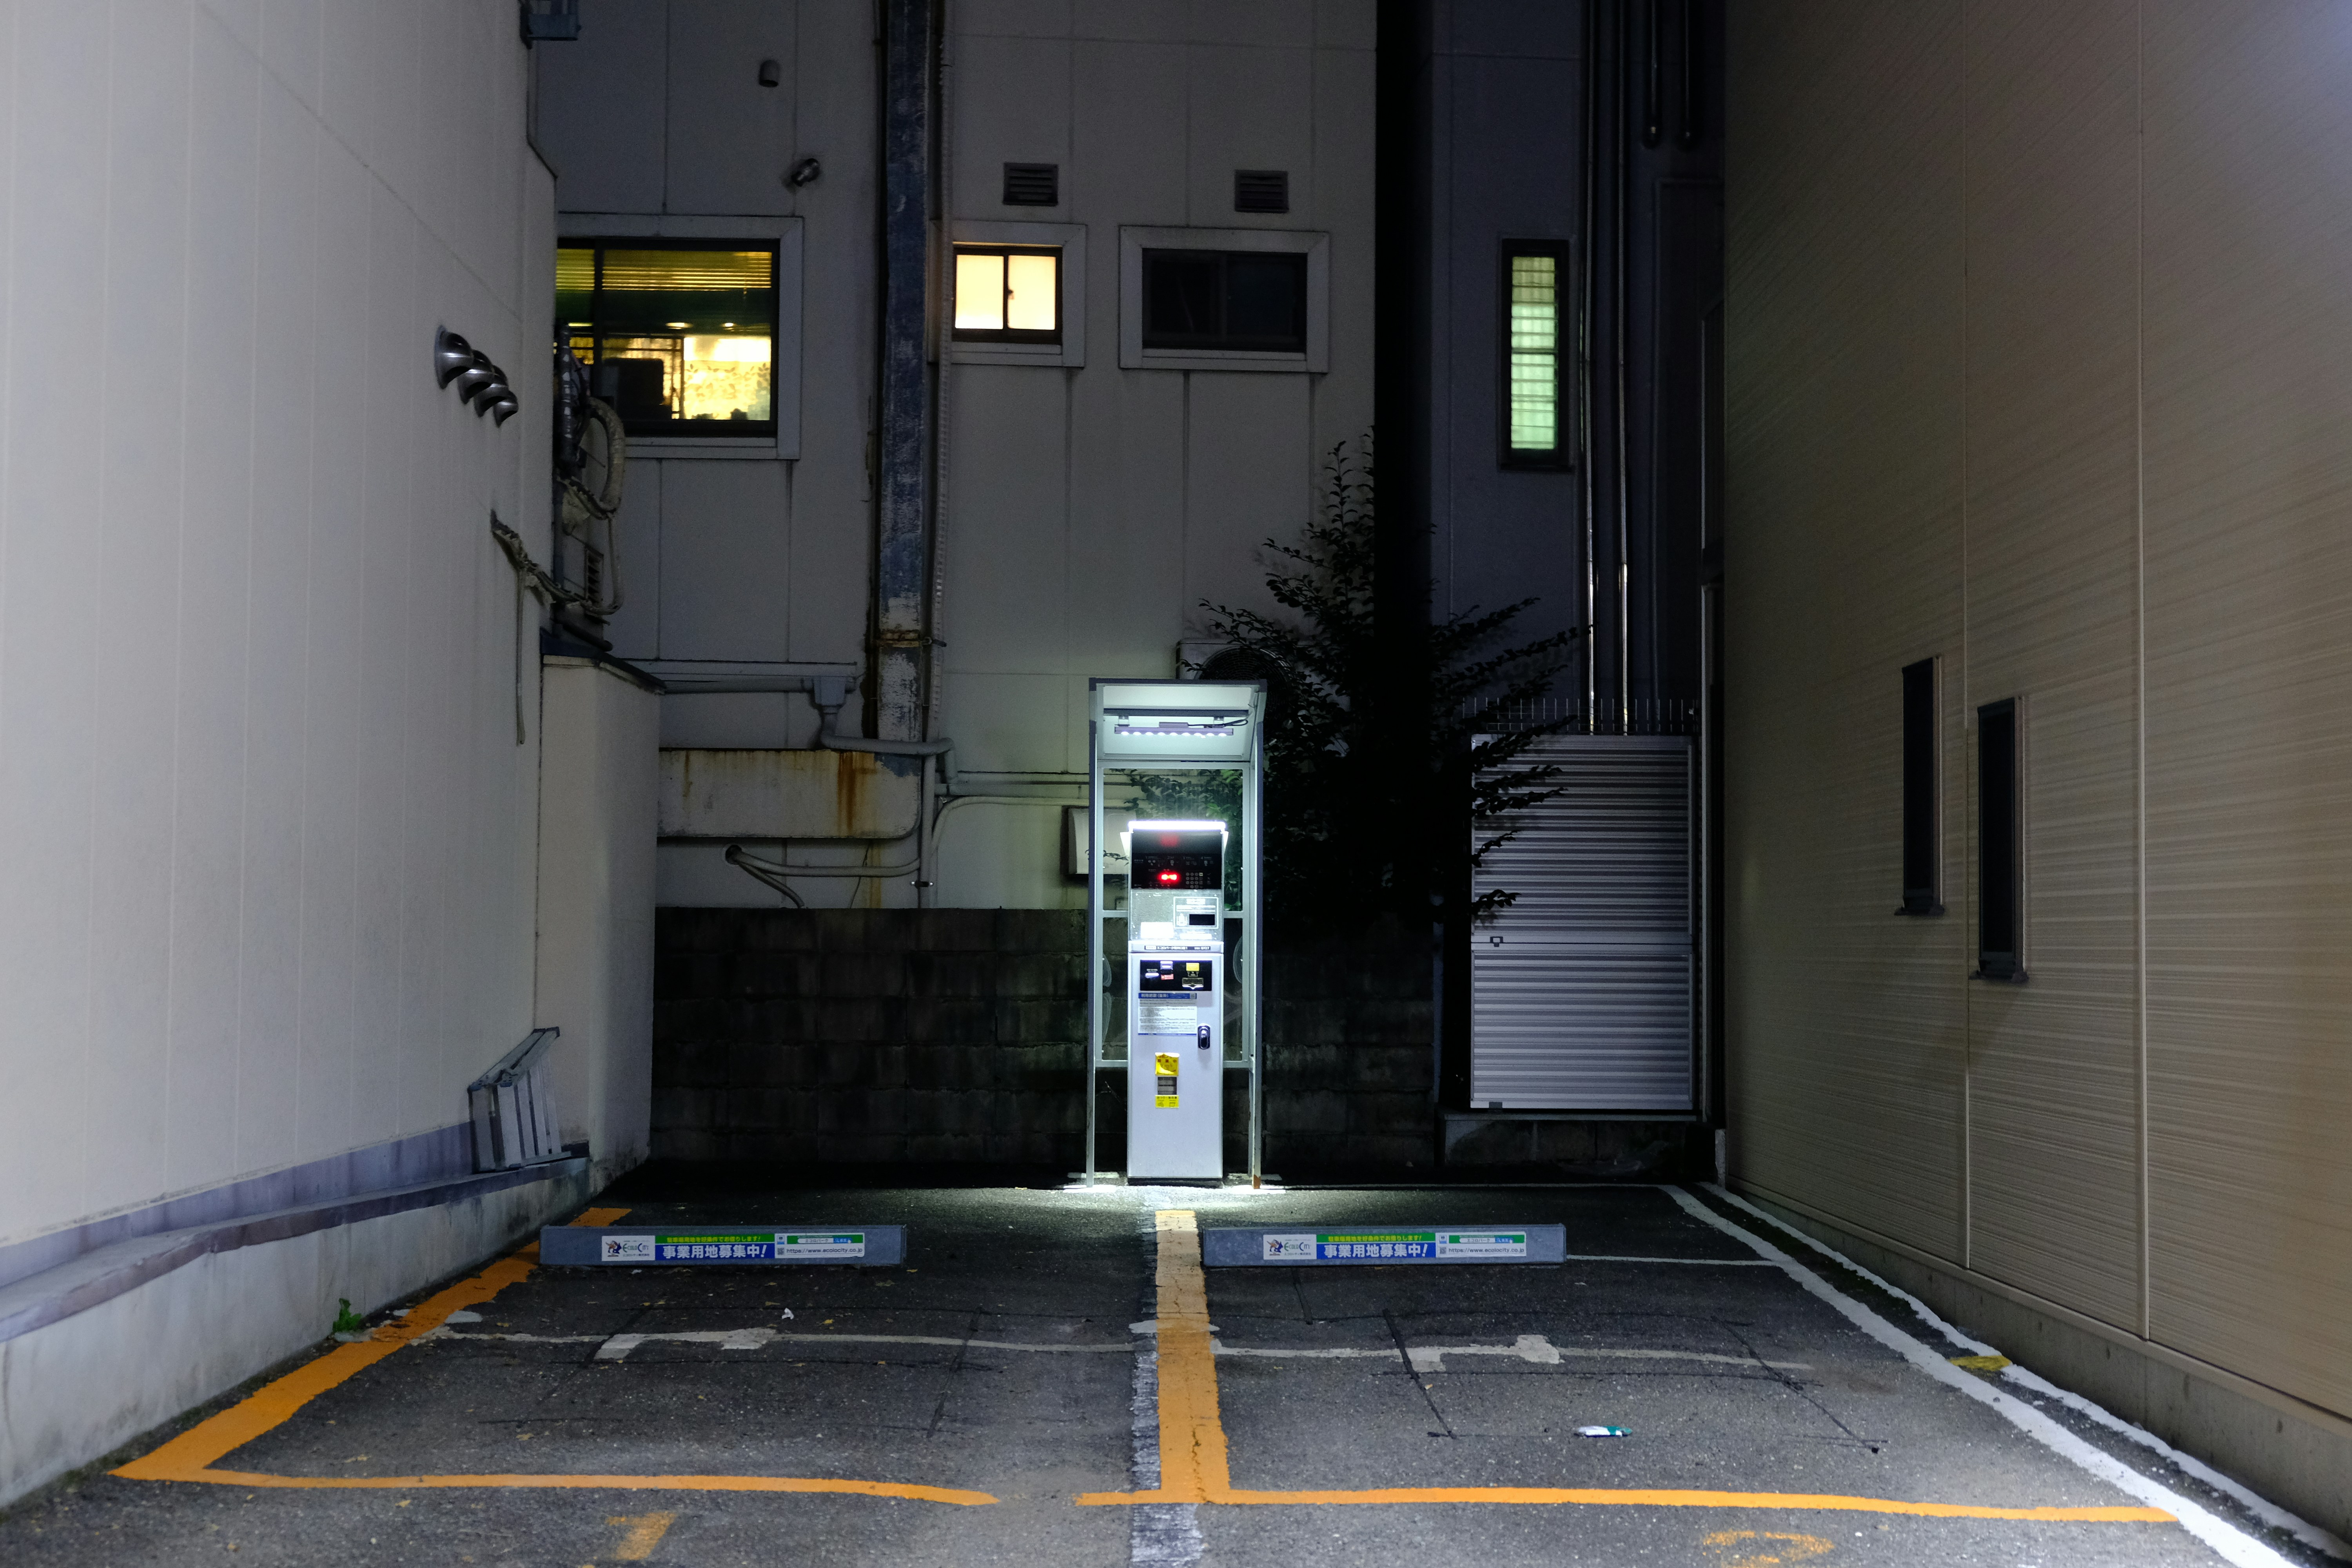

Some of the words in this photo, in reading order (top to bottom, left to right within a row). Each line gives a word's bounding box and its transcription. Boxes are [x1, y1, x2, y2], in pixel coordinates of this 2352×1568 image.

[662, 1244, 767, 1259] 事業用地募集中!
[1324, 1243, 1428, 1258] 事業用地募集中!
